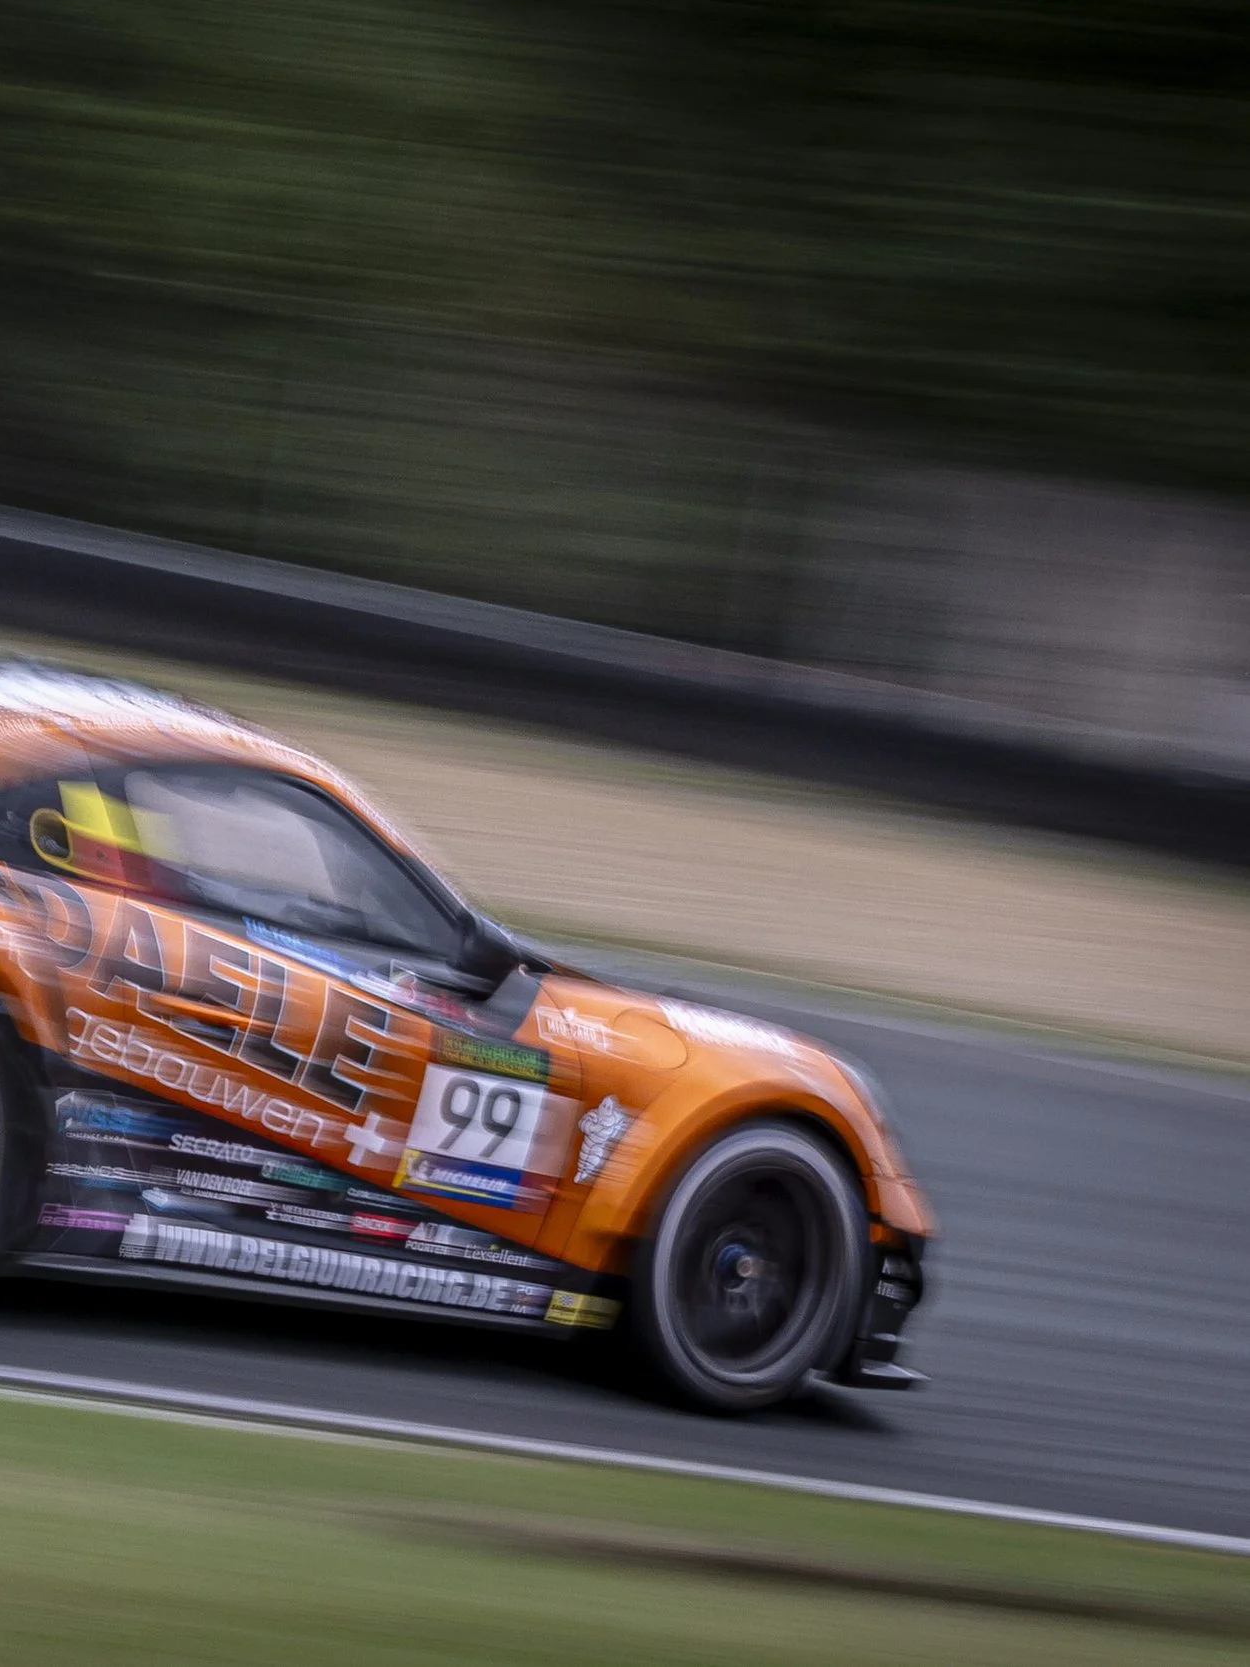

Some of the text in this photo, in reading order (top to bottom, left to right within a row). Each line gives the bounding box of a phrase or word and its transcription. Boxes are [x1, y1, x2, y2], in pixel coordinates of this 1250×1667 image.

[436, 1075, 522, 1158] 99
[430, 1167, 508, 1192] MICHELIN
[153, 1222, 509, 1311] WWW.BELGIUMRACING.BE
